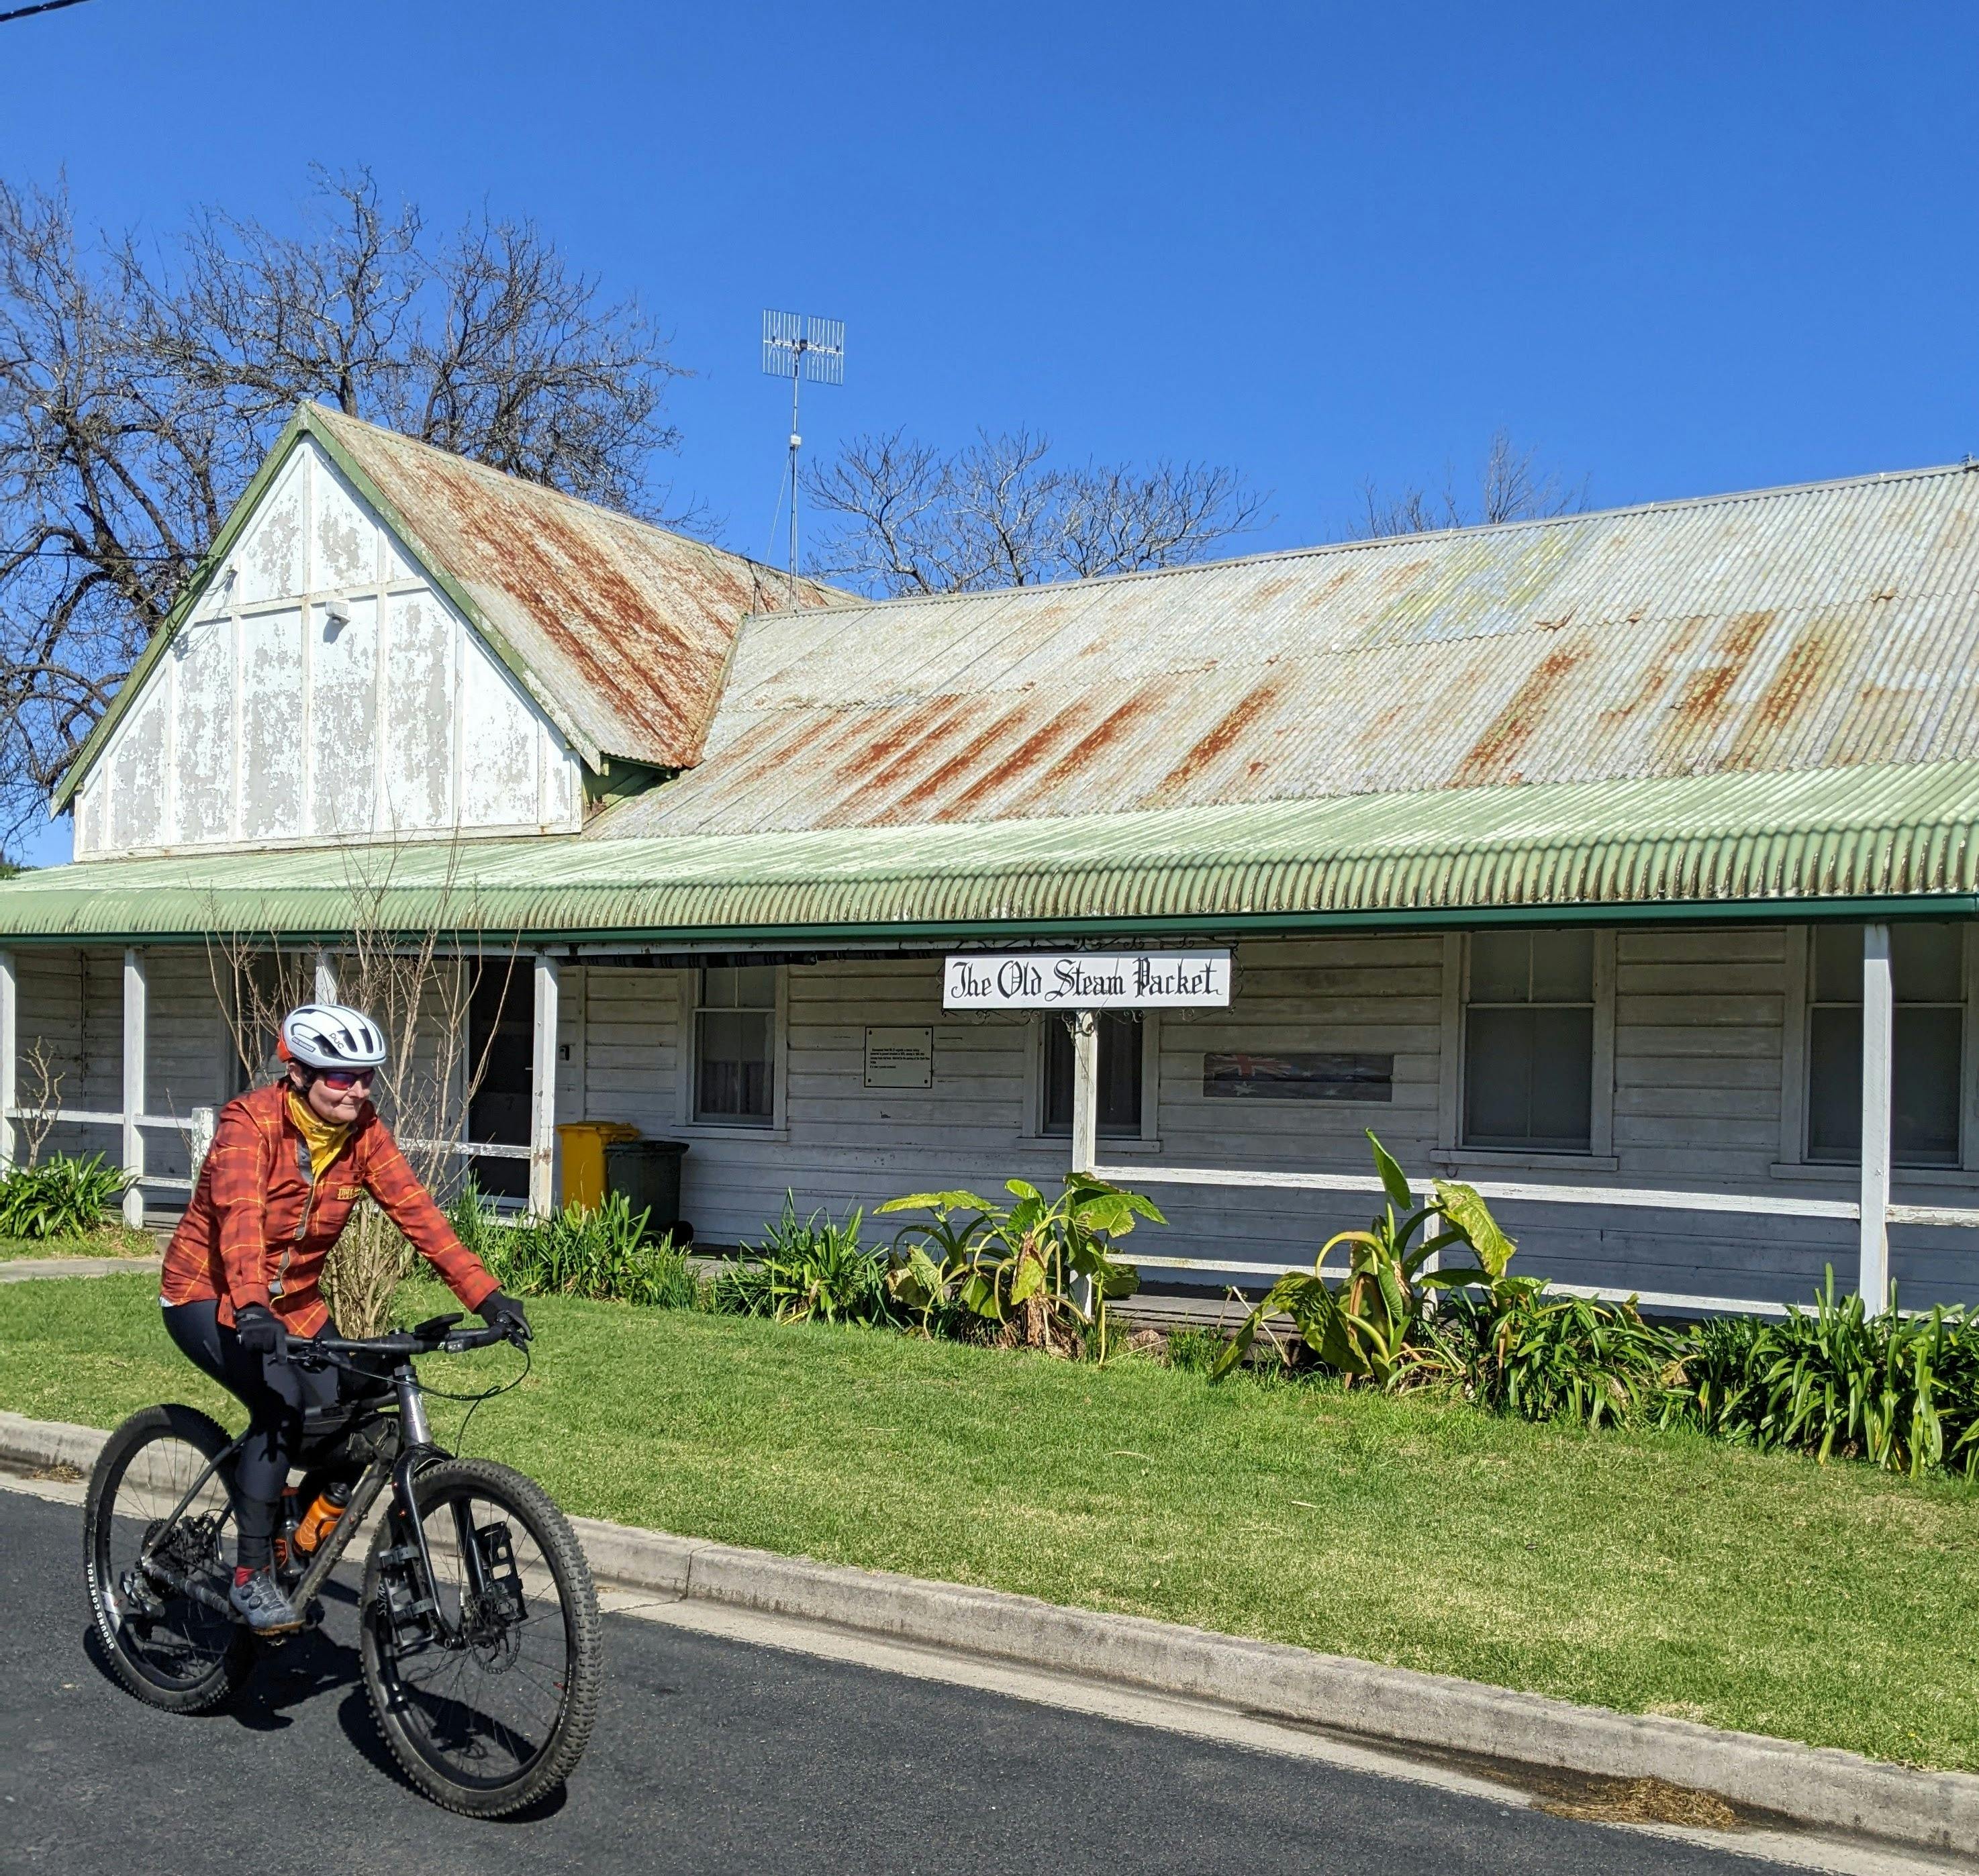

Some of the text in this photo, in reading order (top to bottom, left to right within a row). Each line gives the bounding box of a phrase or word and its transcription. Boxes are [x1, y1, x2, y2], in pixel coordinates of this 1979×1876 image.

[951, 957, 1222, 1002] The Old Steam Packet
[87, 1562, 114, 1650] GROUND CONTROL
